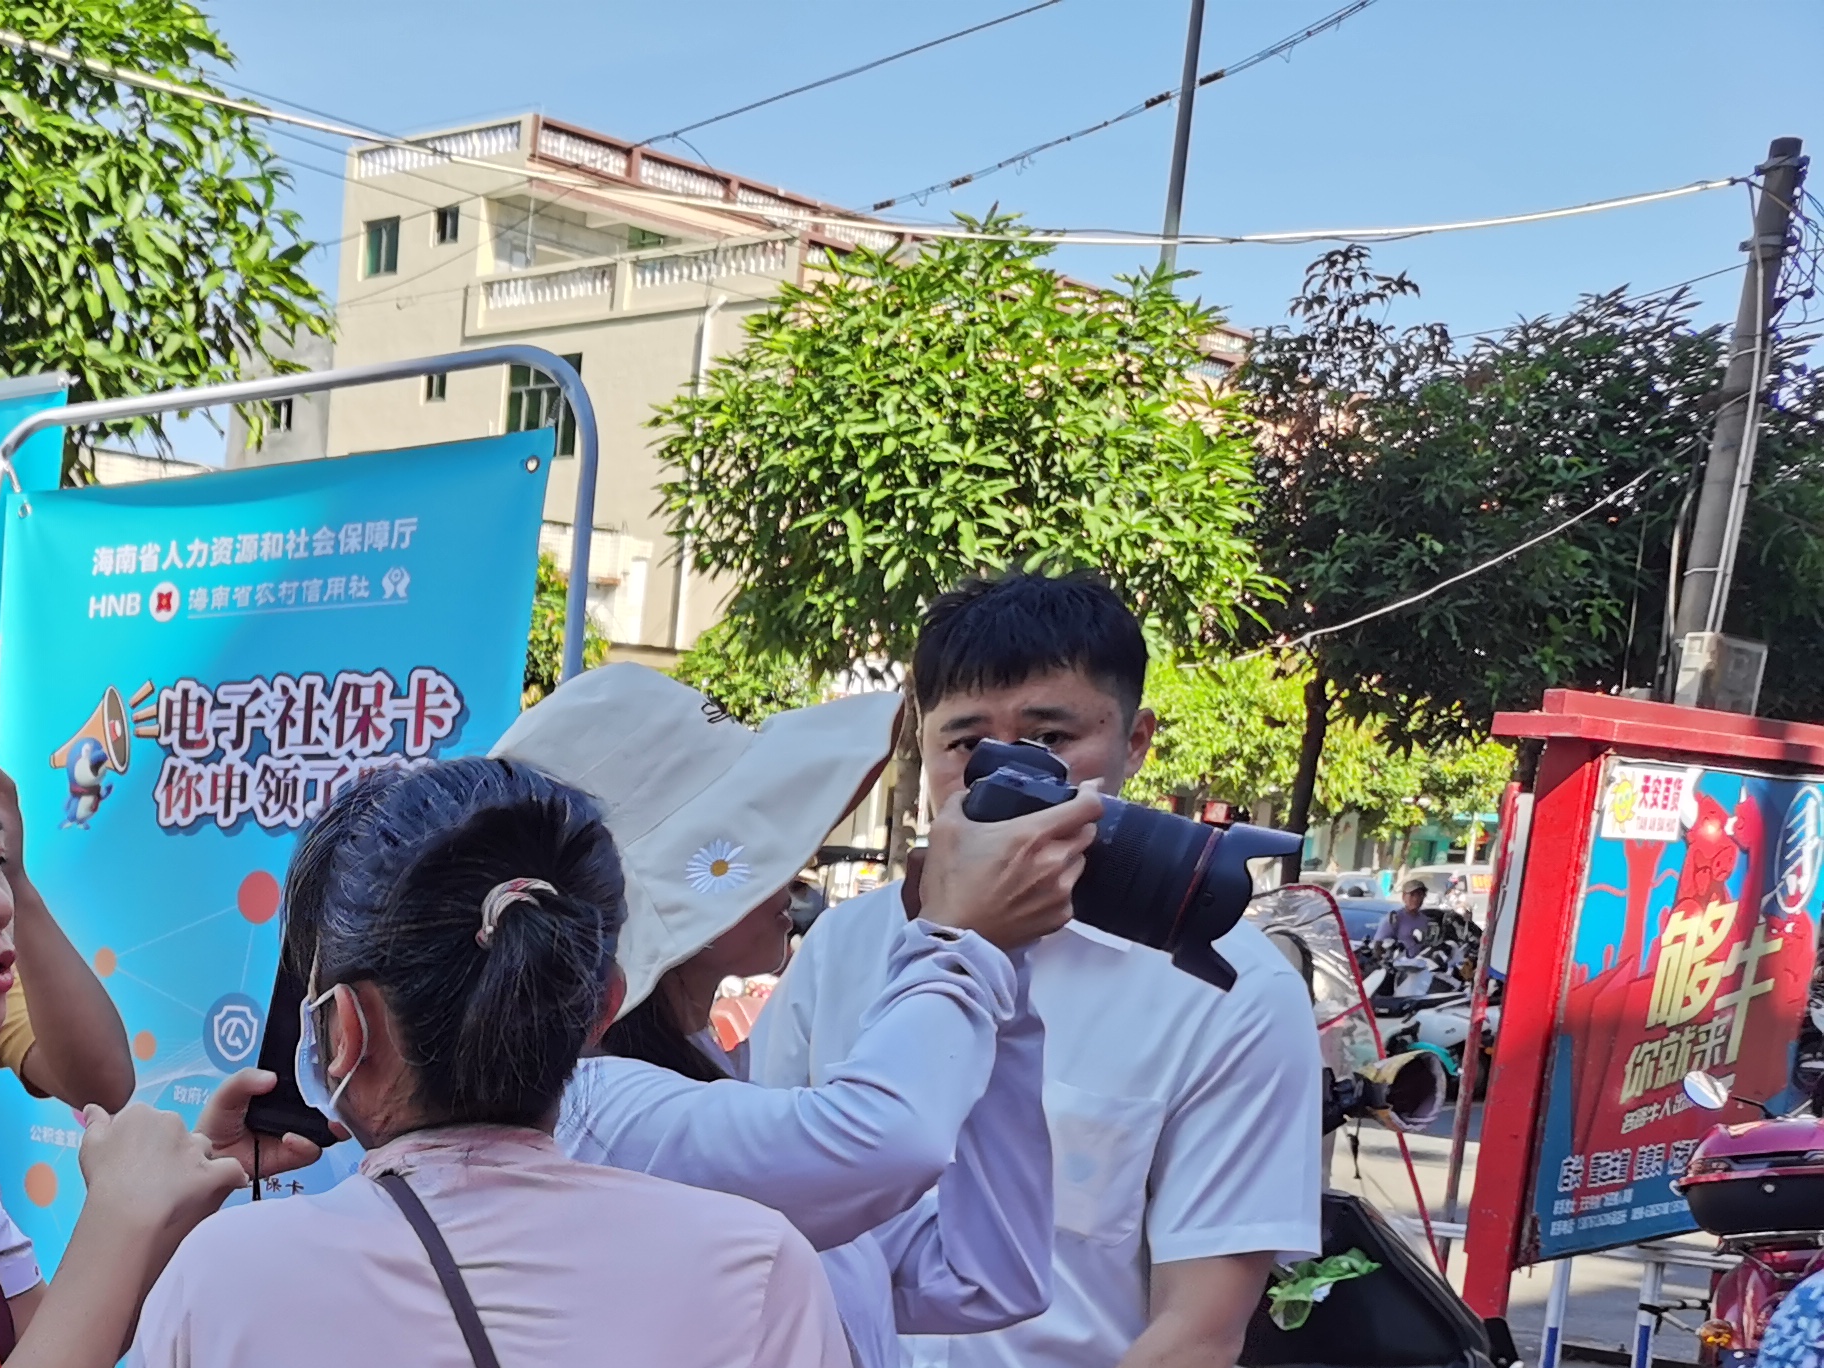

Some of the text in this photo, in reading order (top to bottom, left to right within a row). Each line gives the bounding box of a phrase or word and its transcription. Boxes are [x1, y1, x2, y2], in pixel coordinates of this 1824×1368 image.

[92, 517, 418, 577] 海南省人力资源和社会保障厅
[88, 592, 141, 619] HNB
[188, 574, 369, 611] 海南省农村信用社
[160, 671, 456, 754] 电子社保卡
[156, 758, 404, 826] 你申领了
[1638, 775, 1683, 811] 天安百货
